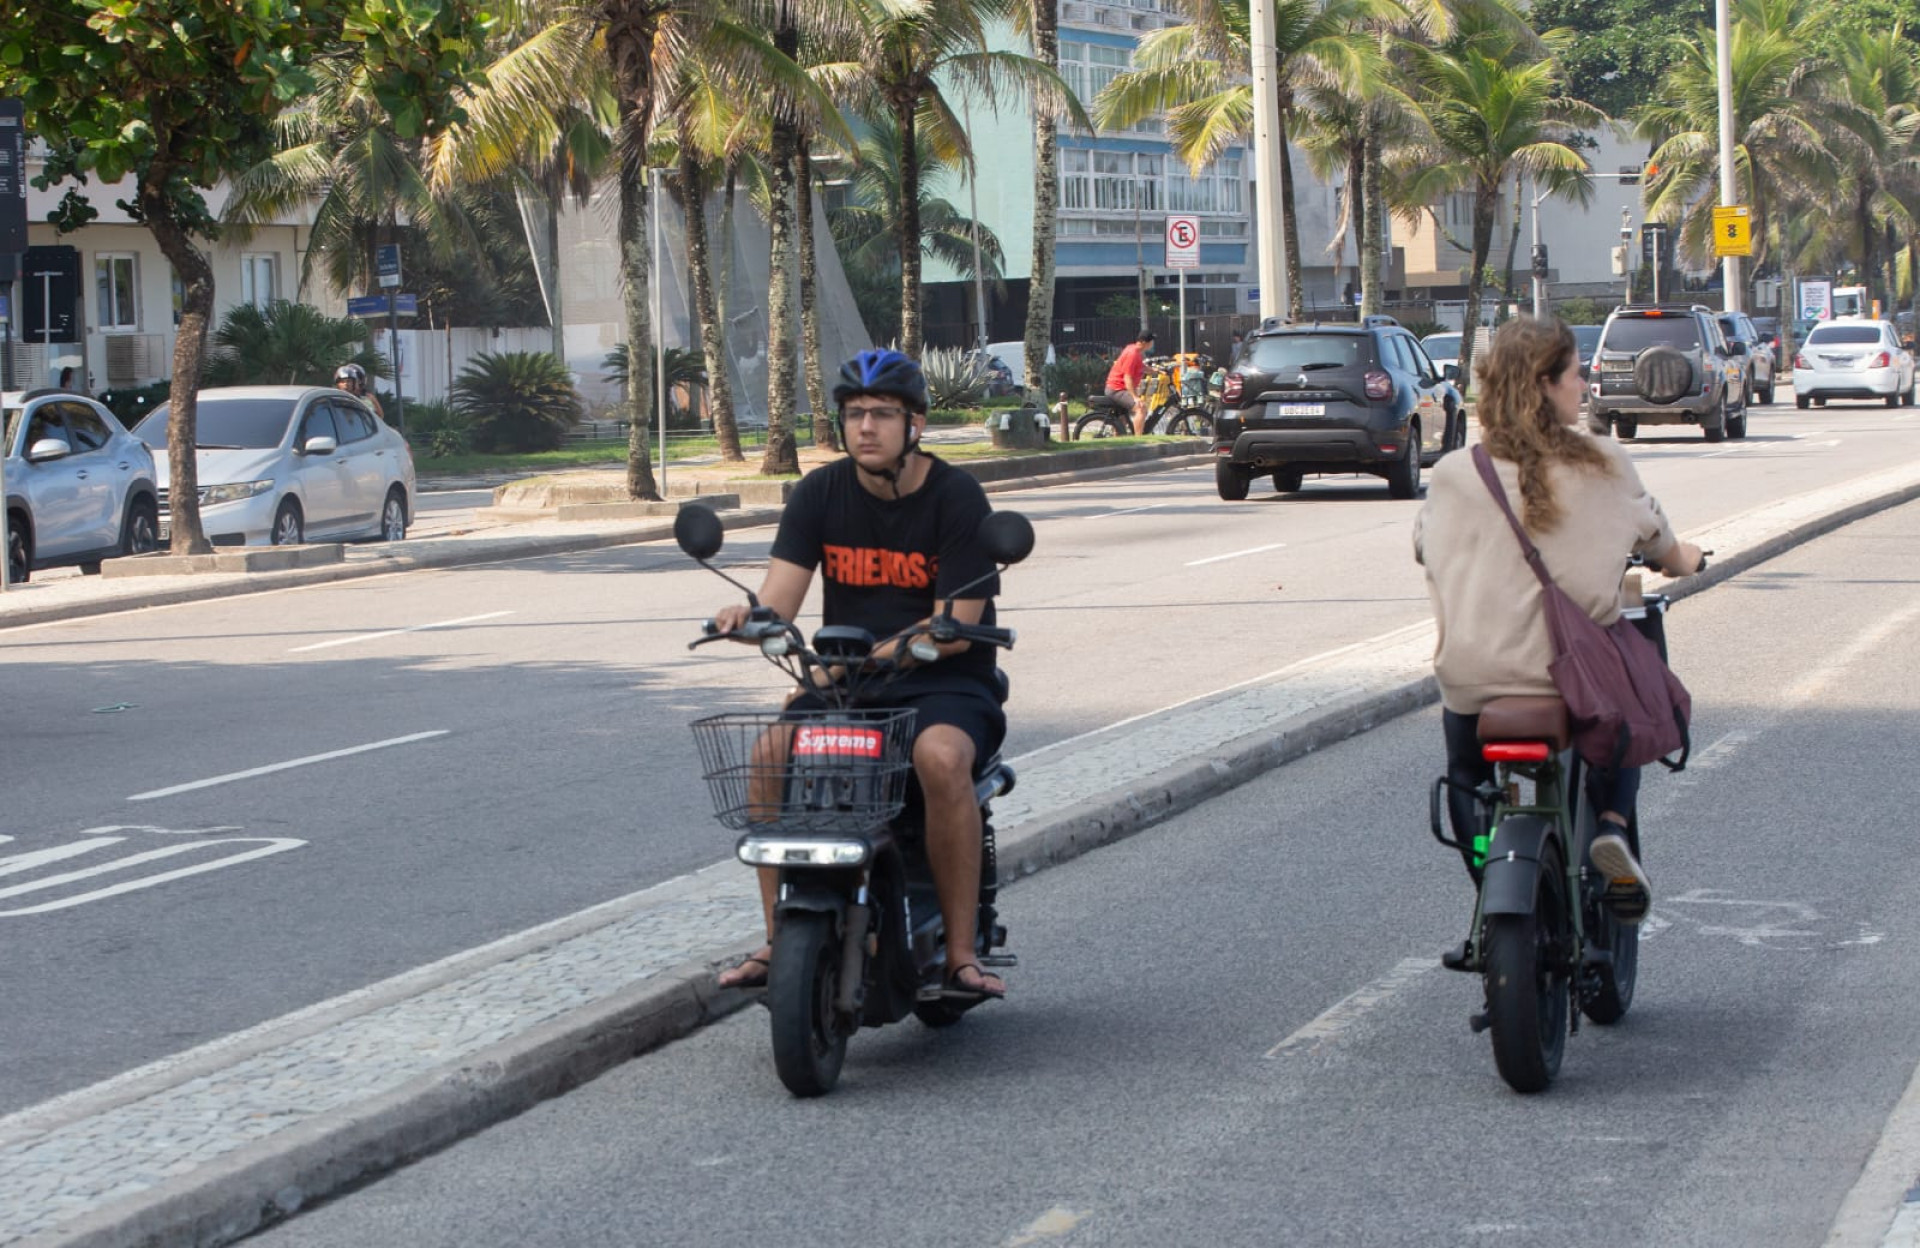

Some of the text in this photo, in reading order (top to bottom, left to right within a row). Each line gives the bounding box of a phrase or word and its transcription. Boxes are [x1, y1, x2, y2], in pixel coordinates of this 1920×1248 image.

[1179, 226, 1188, 242] E
[823, 543, 929, 588] FRIENDS
[798, 727, 876, 752] Supreme
